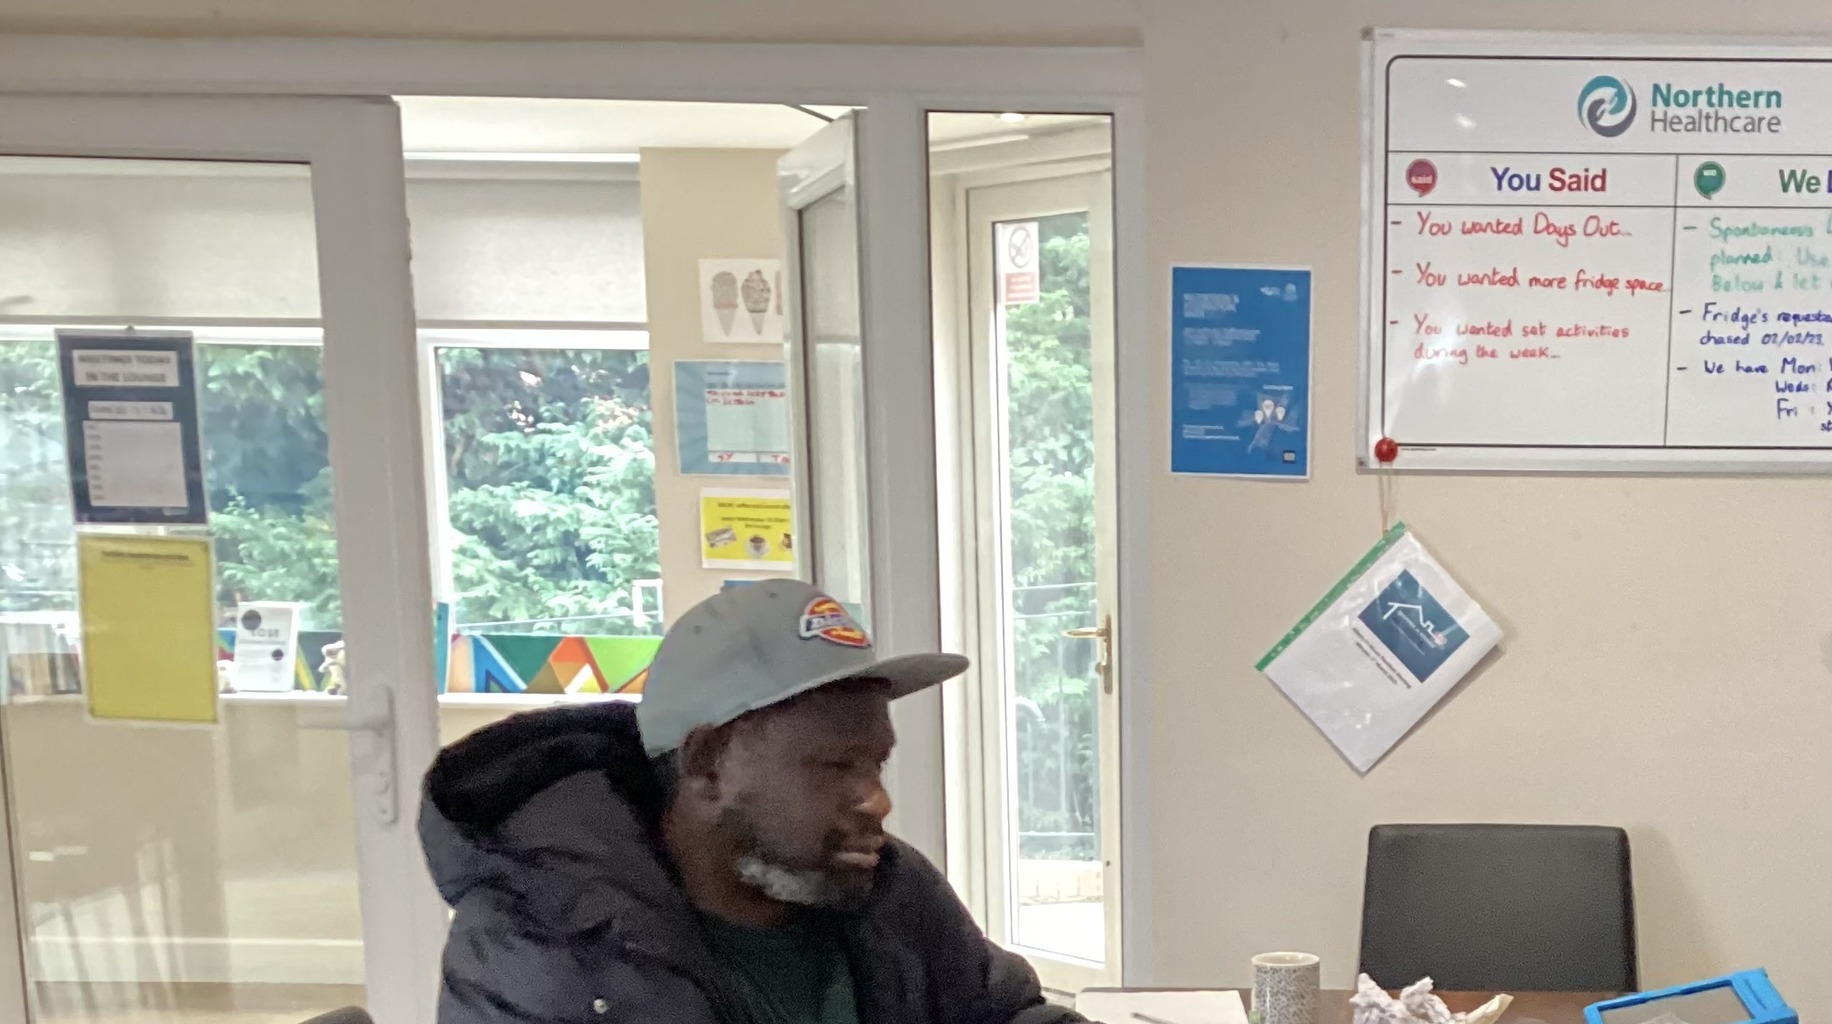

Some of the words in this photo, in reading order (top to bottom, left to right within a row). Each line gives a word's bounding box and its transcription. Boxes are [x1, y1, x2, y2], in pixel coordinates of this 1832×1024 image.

[1652, 83, 1782, 108] Northern
[1651, 109, 1782, 133] Healthcare
[1490, 167, 1541, 191] You
[1548, 167, 1607, 192] Said
[1779, 169, 1821, 193] We
[1417, 211, 1452, 236] You
[1461, 217, 1523, 236] wanted
[1533, 211, 1577, 247] Days
[1416, 261, 1447, 287] You
[1458, 267, 1520, 287] wanted
[1529, 276, 1567, 289] more
[1575, 269, 1620, 296] fridge
[1712, 274, 1764, 292] Below
[1414, 313, 1442, 336] You
[1456, 319, 1513, 337] wanted
[1522, 322, 1547, 337] set
[1556, 324, 1630, 338] activities
[1702, 302, 1768, 330] Fridge's
[1700, 330, 1750, 345] chased
[1414, 342, 1468, 364] during
[1476, 344, 1498, 359] the
[1704, 360, 1725, 374] We
[1735, 360, 1769, 374] have
